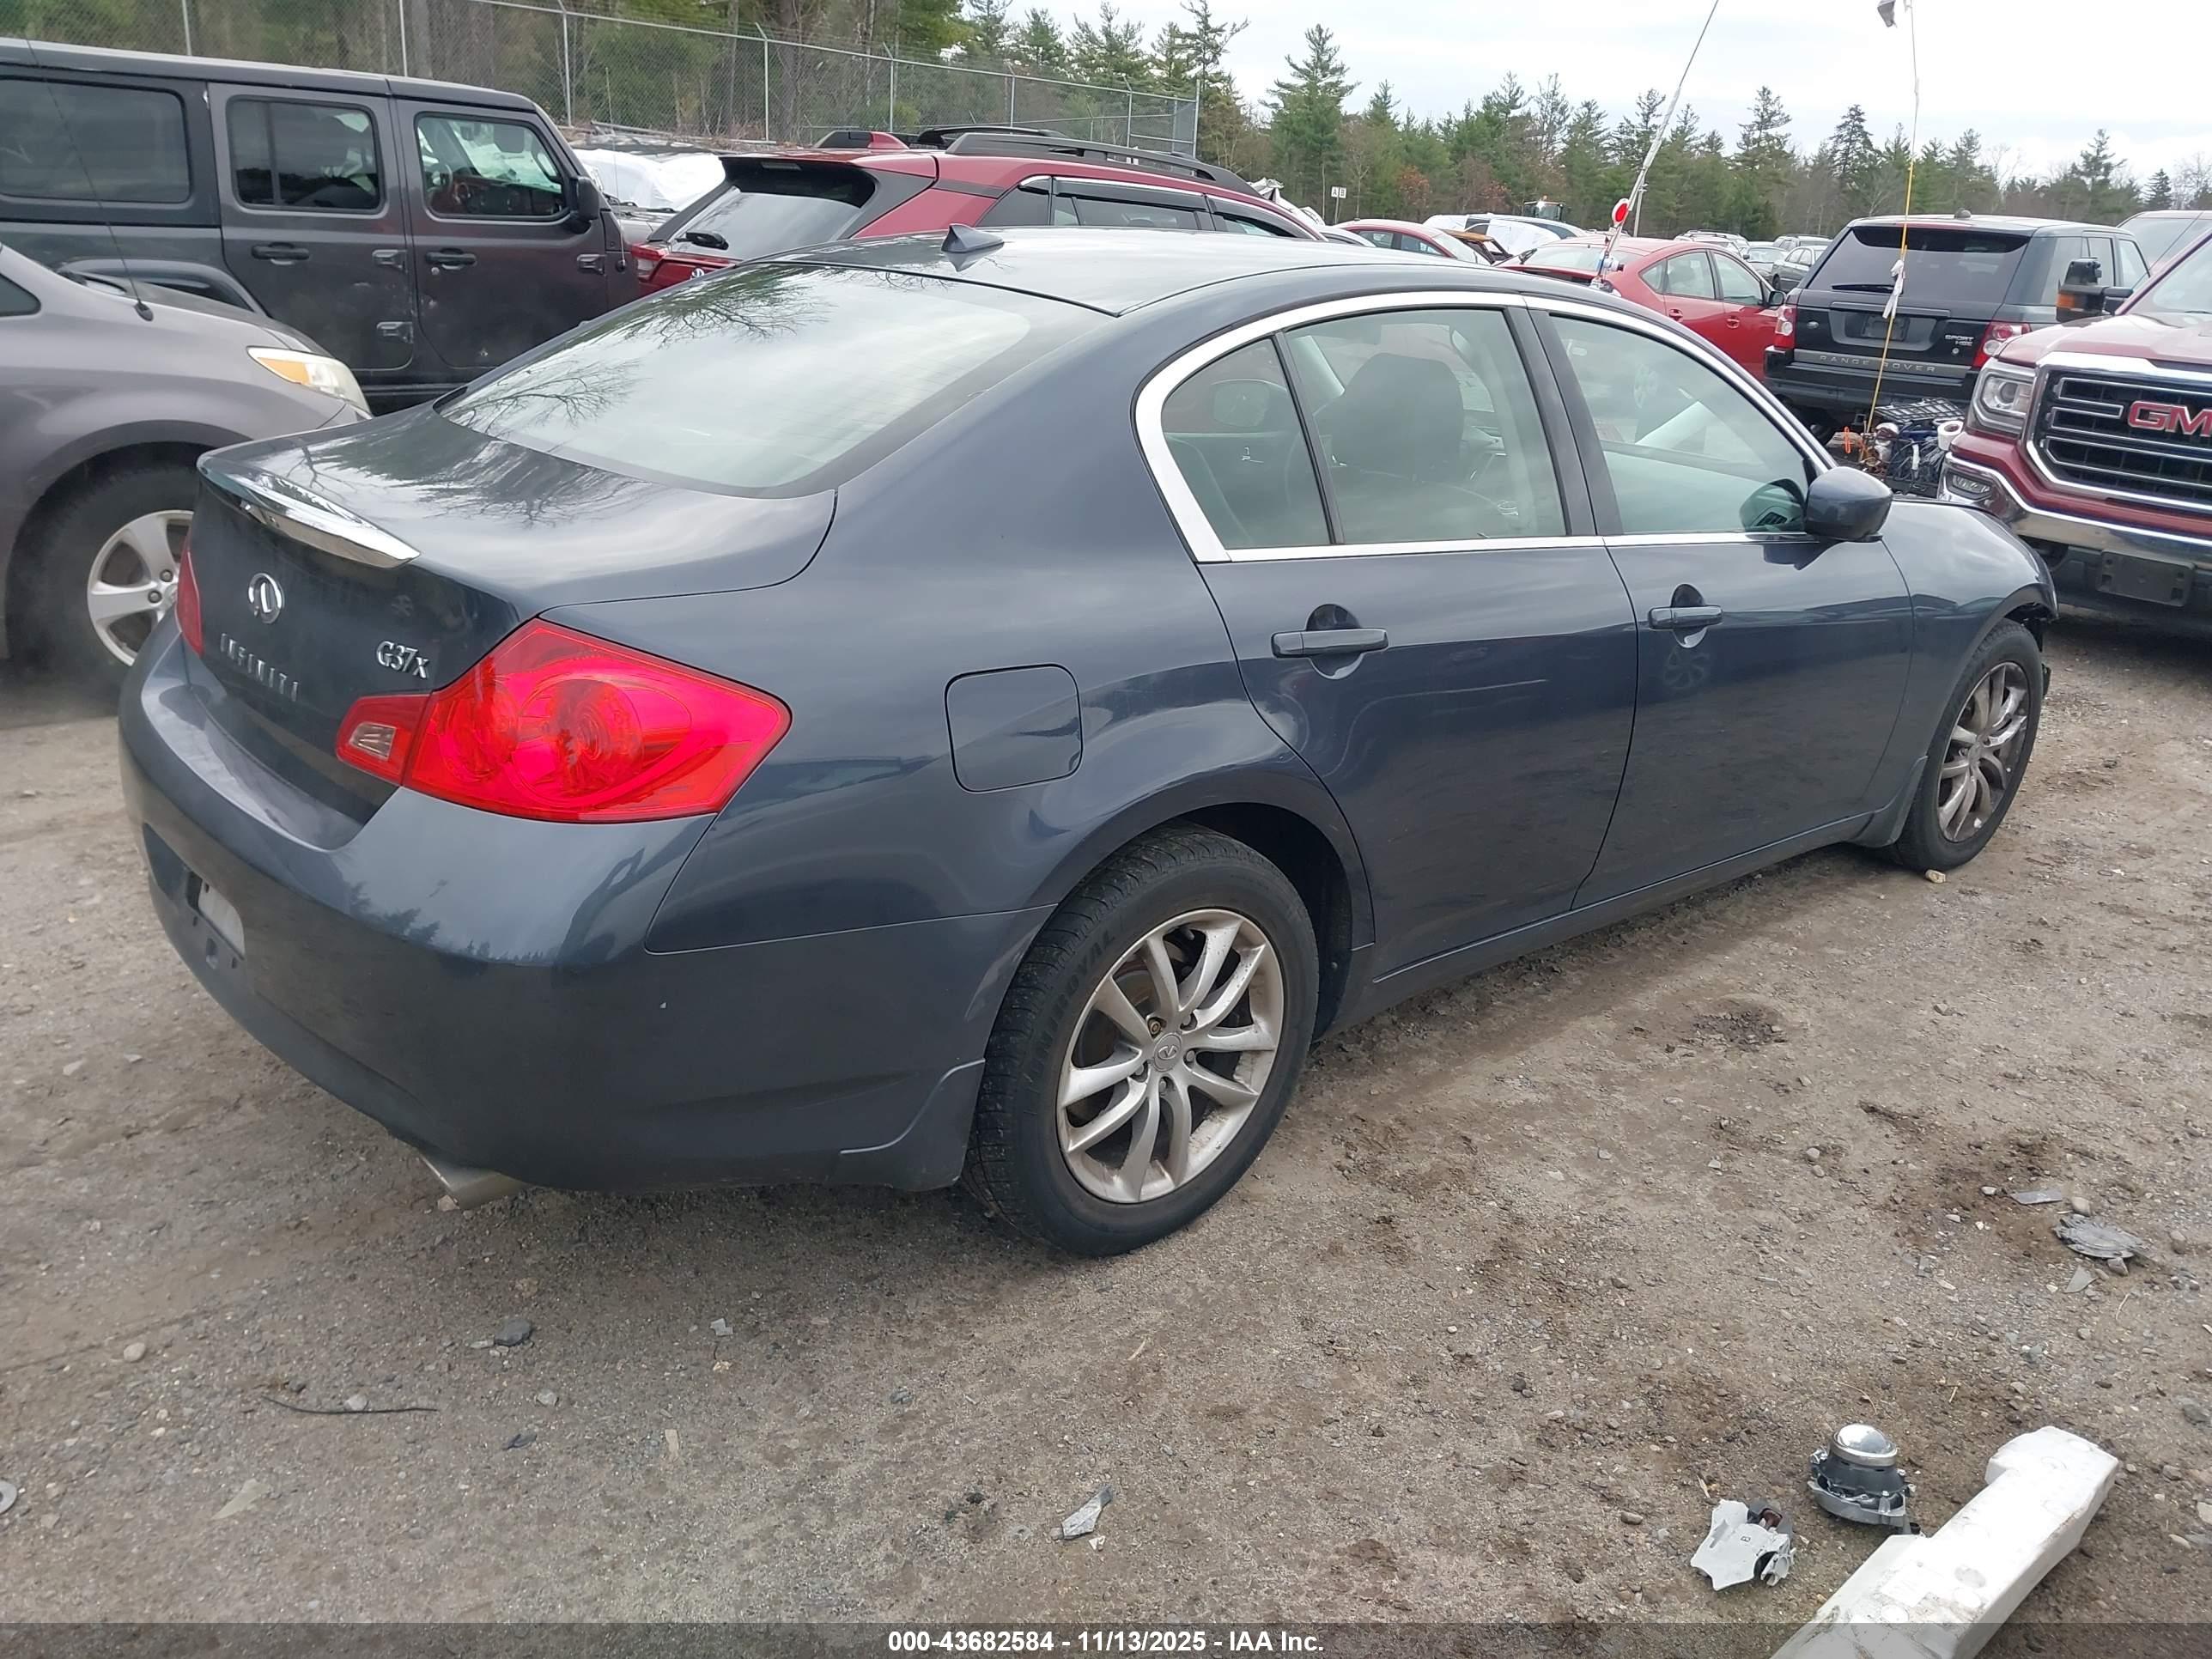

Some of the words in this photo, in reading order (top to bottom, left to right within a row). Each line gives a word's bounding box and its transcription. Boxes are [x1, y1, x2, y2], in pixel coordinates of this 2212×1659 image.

[1820, 355, 1869, 366] RANGE
[1882, 361, 1936, 372] ROVER
[2128, 401, 2212, 437] GM
[220, 633, 298, 702] INFINITI
